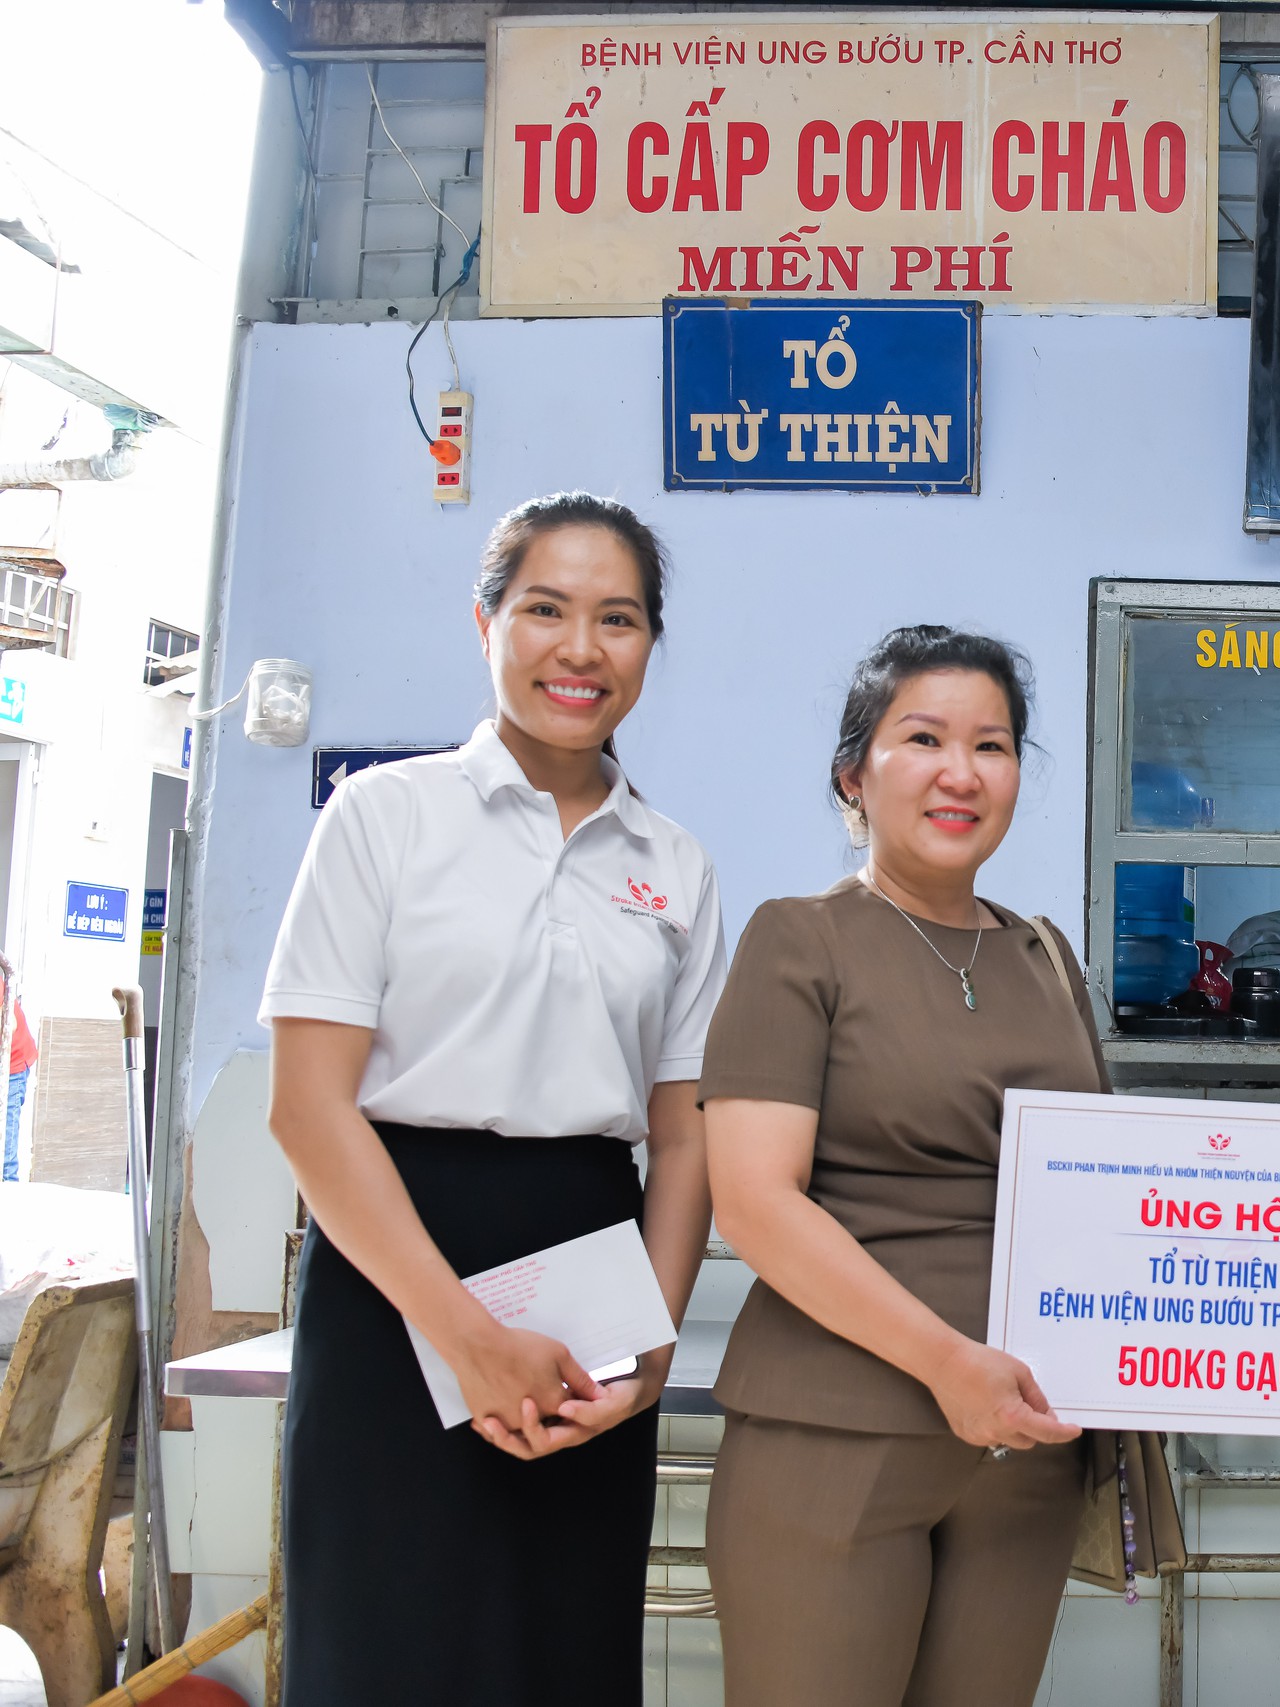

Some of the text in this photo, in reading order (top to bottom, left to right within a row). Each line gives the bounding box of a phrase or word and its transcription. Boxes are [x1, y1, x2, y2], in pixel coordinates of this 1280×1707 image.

[582, 30, 1120, 70] BỆNH VIỆN UNG BƯỚU TP. CẦN THƠ
[515, 86, 1186, 214] TỔ CẤP CƠM CHÁO
[678, 226, 1012, 291] MIỄN PHÍ
[784, 316, 856, 389] TỔ
[691, 400, 951, 472] TỪ THIỆN
[1047, 1161, 1072, 1171] BSCKII
[1075, 1162, 1095, 1173] PHAN
[1098, 1163, 1119, 1175] TRỊNH
[1122, 1165, 1141, 1175] MINH
[1144, 1163, 1161, 1176] HIẾU
[1164, 1164, 1173, 1176] VÀ
[1176, 1166, 1197, 1178] NHÓM
[1201, 1167, 1222, 1180] THIỆN
[1225, 1169, 1255, 1182] NGUYỆN
[1257, 1169, 1272, 1182] CỦA
[1141, 1188, 1222, 1230] ỦNG
[1149, 1248, 1277, 1294] TỔ TỪ THIỆN
[1040, 1288, 1094, 1322] BỆNH
[1101, 1291, 1147, 1325] VIỆN
[1154, 1298, 1194, 1324] UNG
[1200, 1293, 1256, 1327] BƯỚU
[1118, 1346, 1226, 1390] 500KG
